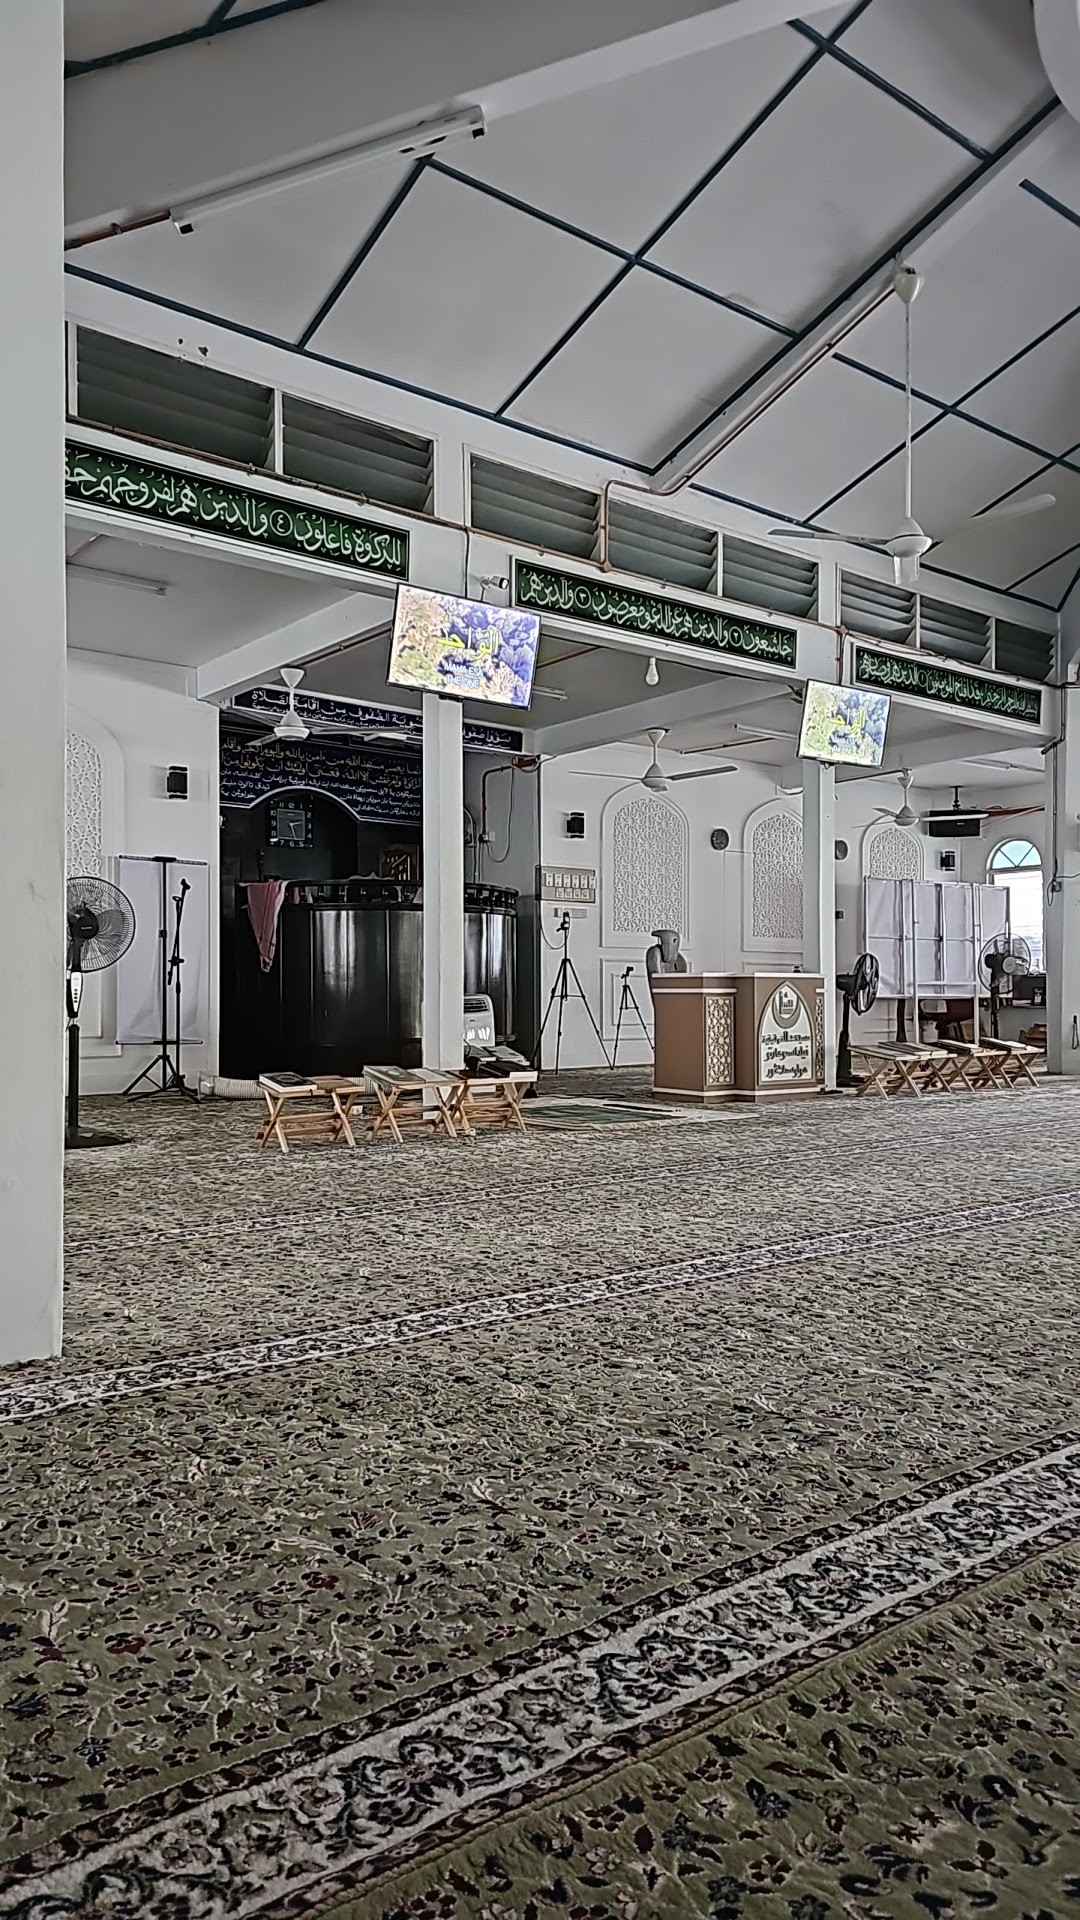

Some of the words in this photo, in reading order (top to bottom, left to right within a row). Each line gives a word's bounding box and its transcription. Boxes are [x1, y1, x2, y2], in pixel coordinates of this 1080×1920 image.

[444, 661, 469, 675] MAHA
[469, 665, 484, 678] ESA
[446, 674, 461, 686] THE
[462, 677, 480, 689] ONE
